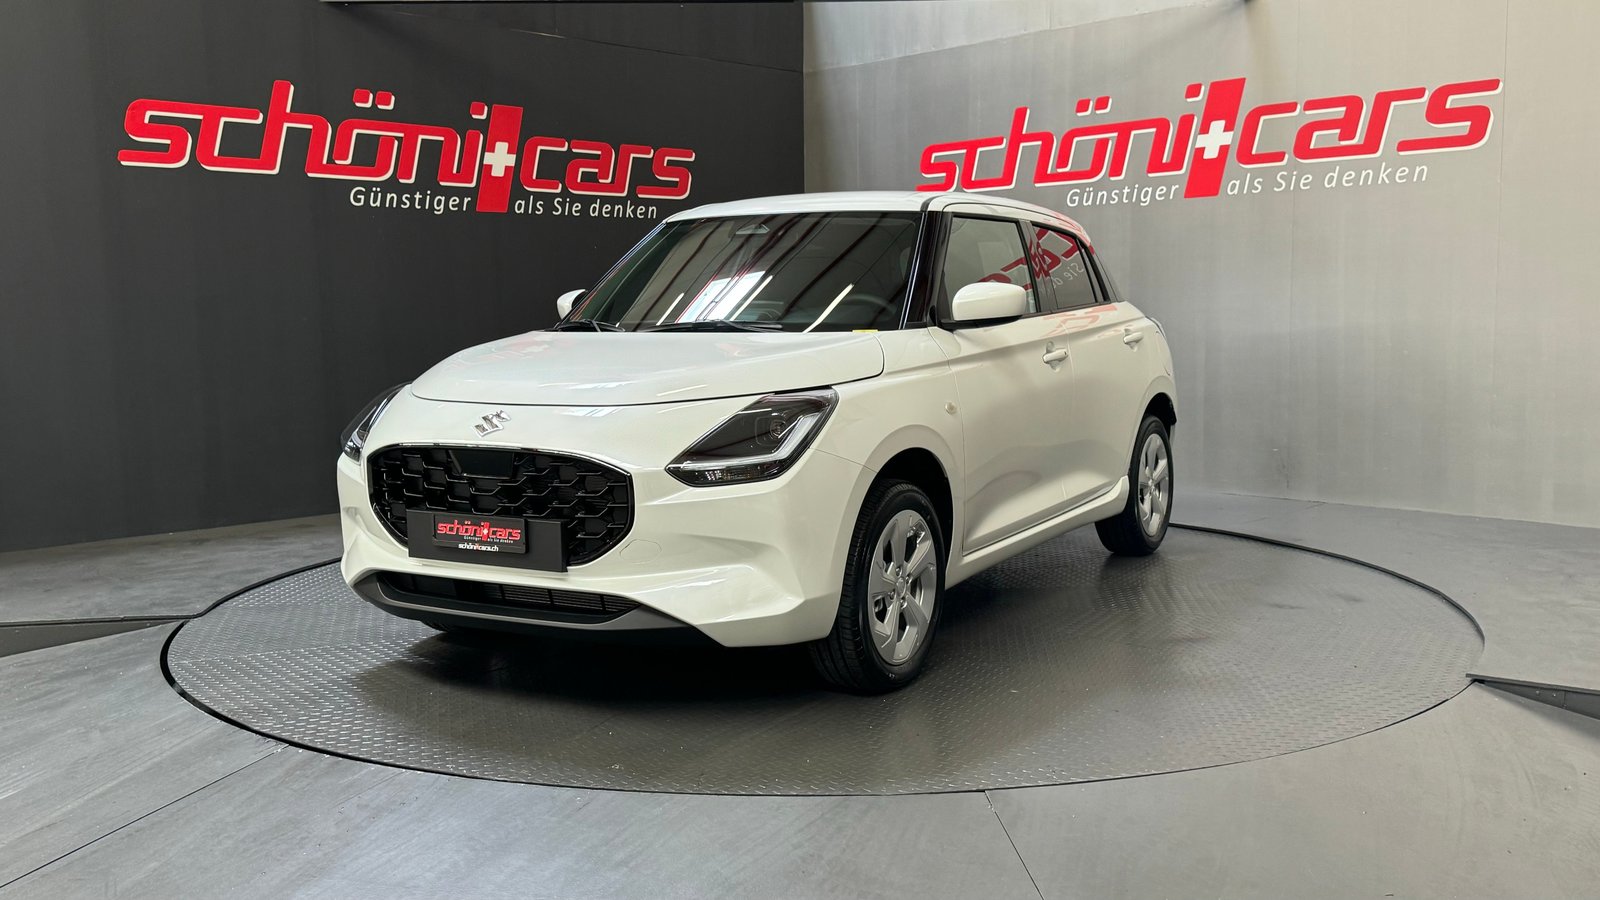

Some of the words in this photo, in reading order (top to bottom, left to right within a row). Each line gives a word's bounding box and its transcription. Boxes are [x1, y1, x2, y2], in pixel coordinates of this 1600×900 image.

[349, 187, 472, 215] Günstiger
[514, 198, 544, 215] als
[552, 197, 582, 216] Sie
[589, 199, 658, 219] denken
[1066, 182, 1180, 208] Günstiger
[1226, 173, 1263, 197] als
[1274, 171, 1312, 192] Sie
[1323, 160, 1429, 189] denken
